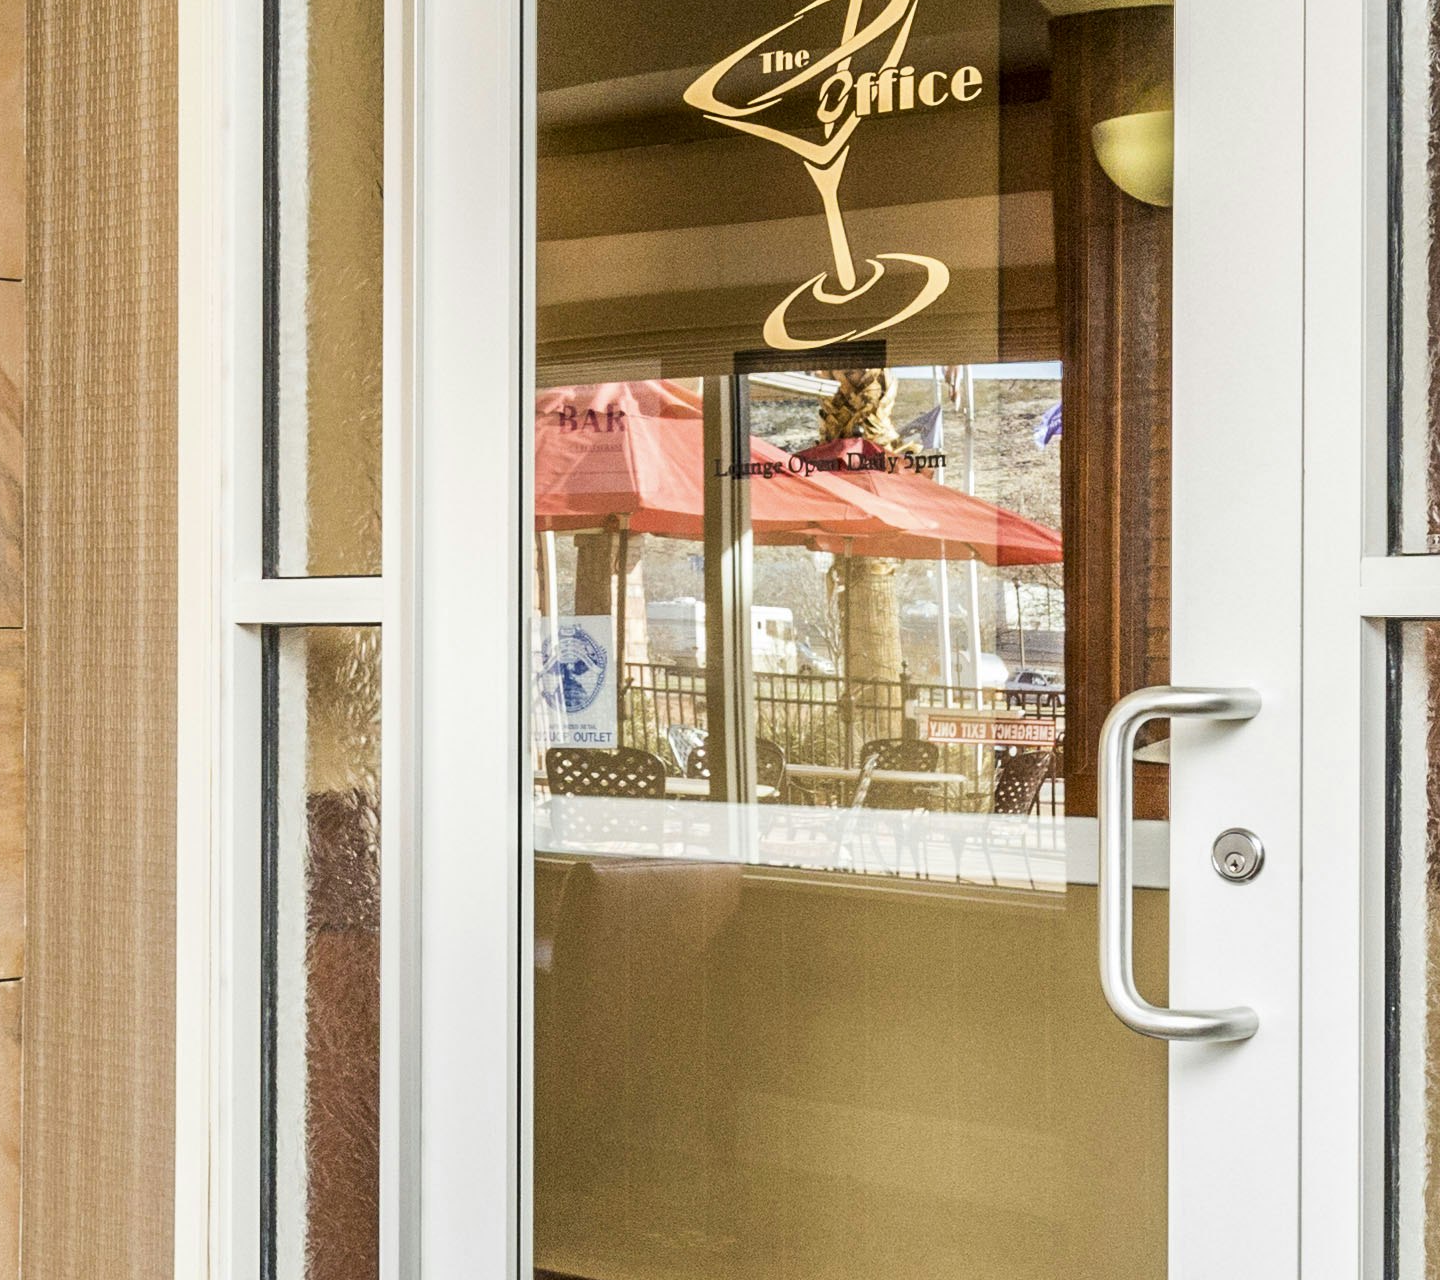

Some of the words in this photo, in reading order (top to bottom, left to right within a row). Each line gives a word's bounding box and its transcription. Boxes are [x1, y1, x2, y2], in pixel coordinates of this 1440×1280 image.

[758, 47, 810, 74] The
[817, 65, 983, 123] Office
[558, 403, 627, 433] BAR
[714, 458, 782, 480] Lounge
[788, 454, 840, 477] Open
[903, 450, 947, 474] 5pm
[573, 731, 613, 743] OUTLET
